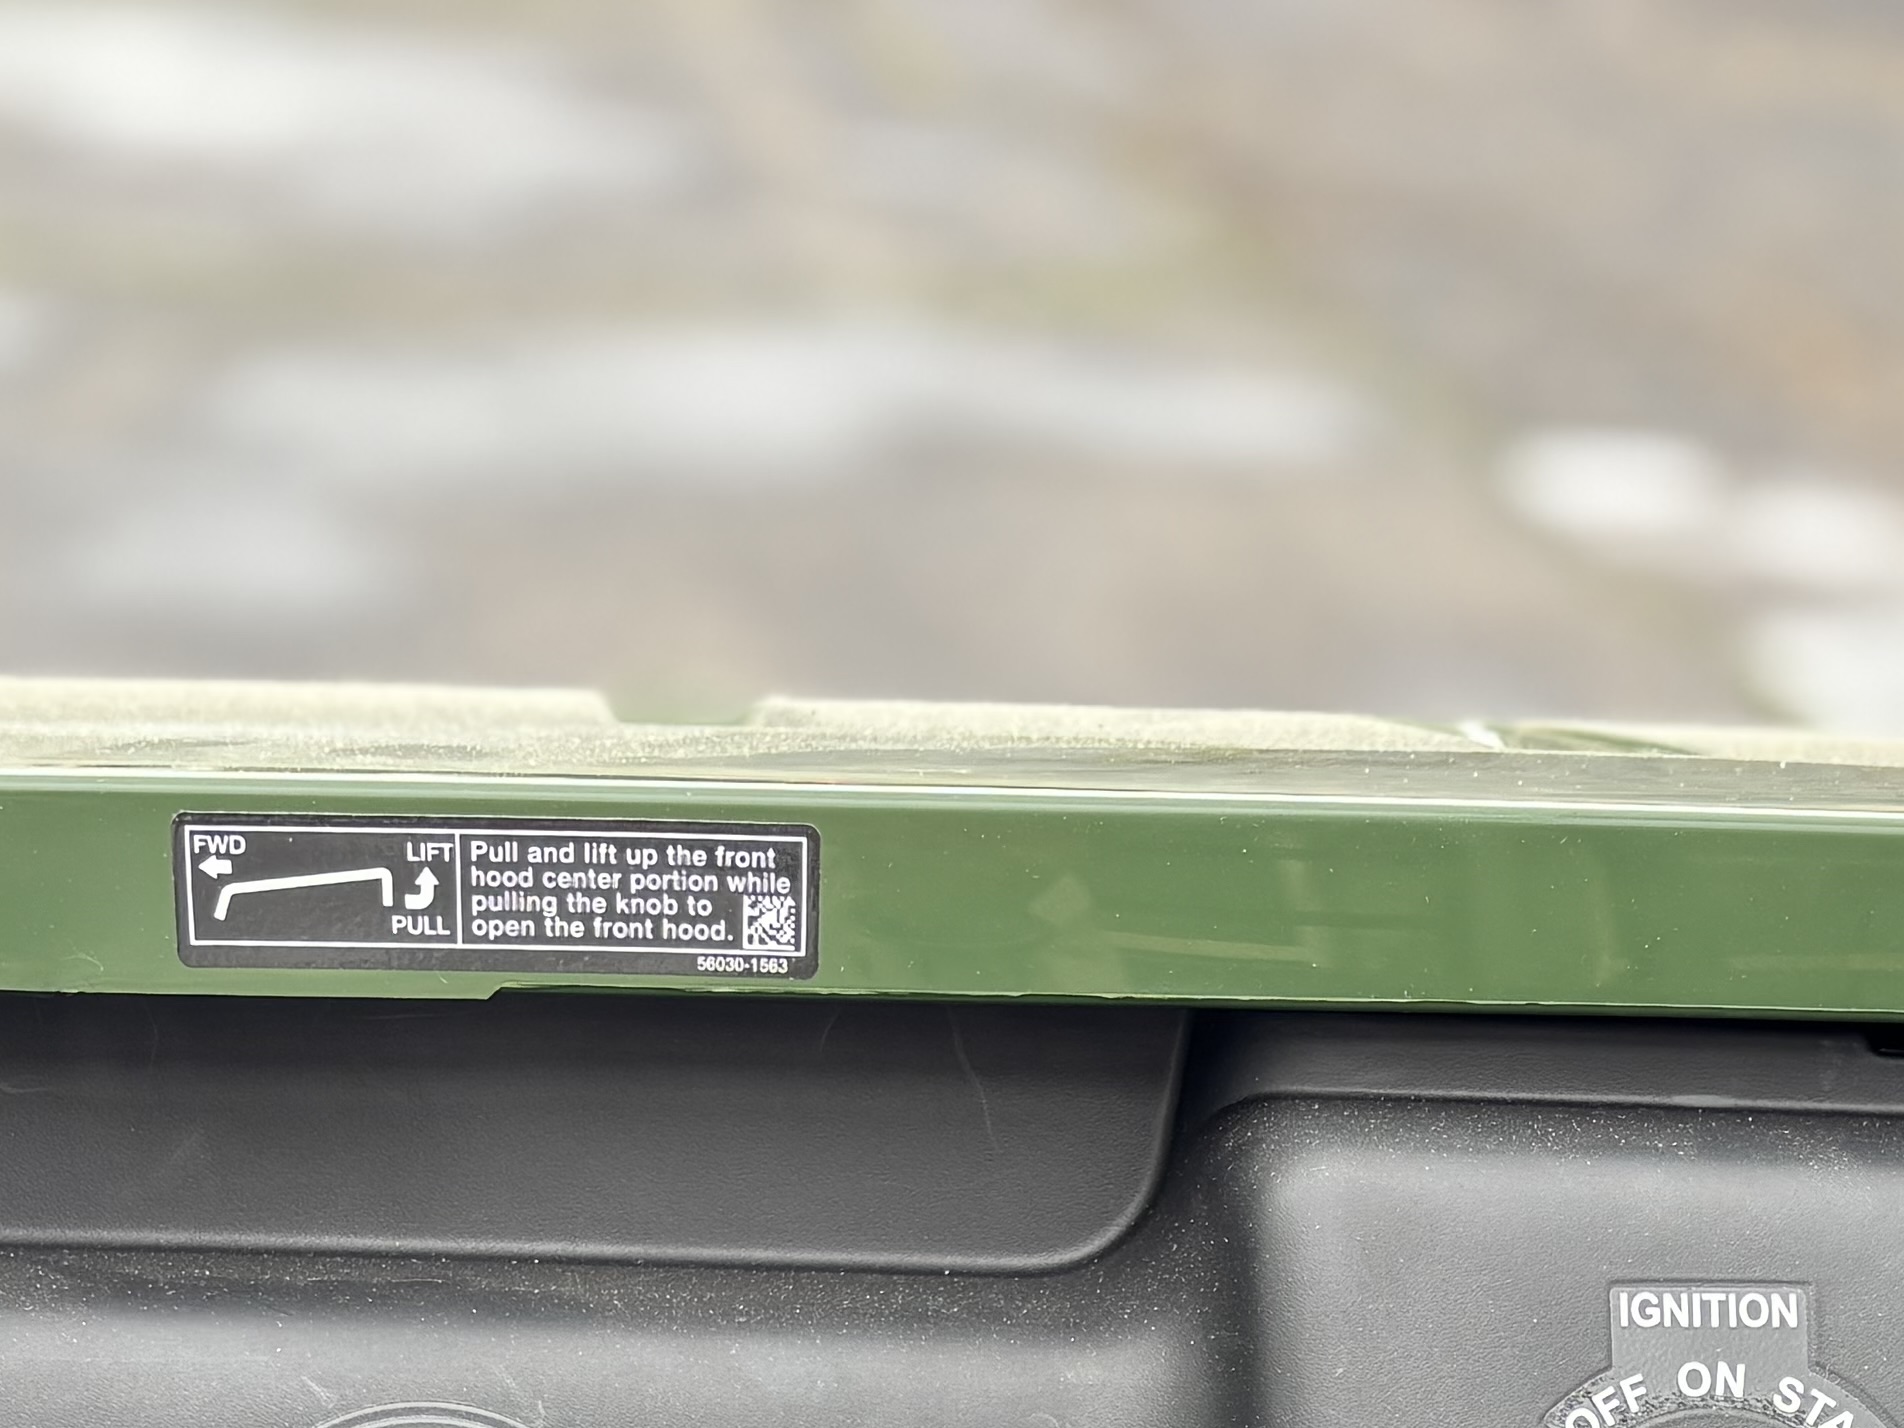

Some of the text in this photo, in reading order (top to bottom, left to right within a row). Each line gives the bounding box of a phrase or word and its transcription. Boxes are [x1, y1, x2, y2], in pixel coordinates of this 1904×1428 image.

[193, 834, 245, 854] FWD
[406, 841, 454, 862] LIFT
[470, 840, 775, 869] Pull and lift up the front
[470, 865, 790, 894] hood center portion while
[471, 891, 712, 917] pulling the knob to
[391, 914, 450, 935] PULL
[471, 916, 733, 940] open the front hood.
[696, 955, 787, 973] 56030-1563
[1619, 1291, 1798, 1328] IGNITION
[1677, 1361, 1746, 1398] ON
